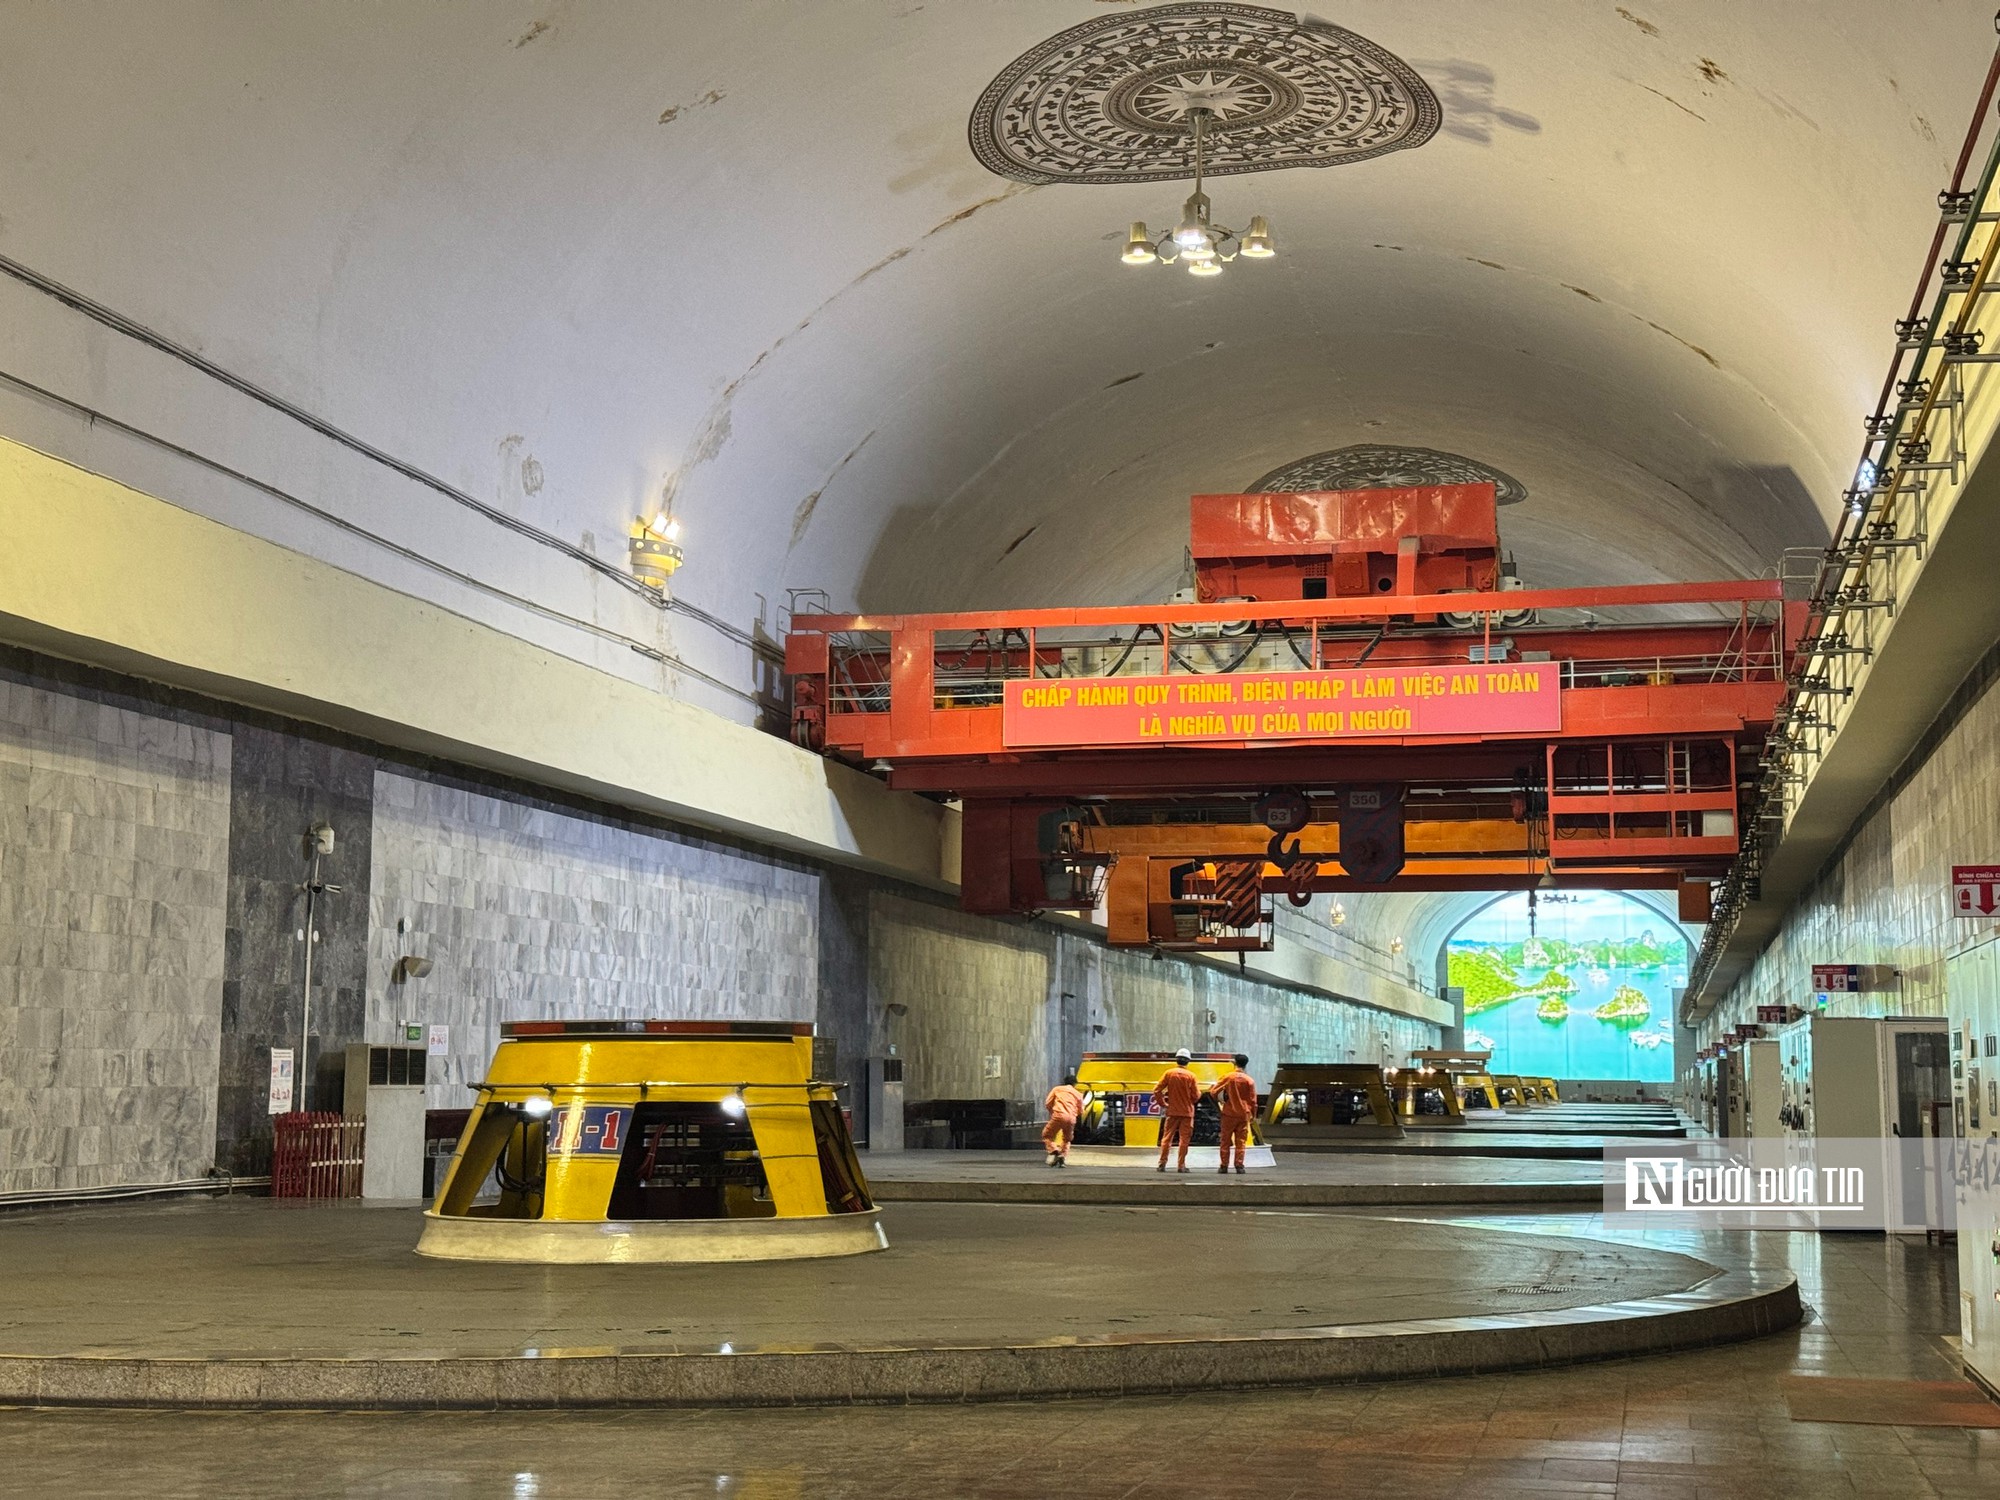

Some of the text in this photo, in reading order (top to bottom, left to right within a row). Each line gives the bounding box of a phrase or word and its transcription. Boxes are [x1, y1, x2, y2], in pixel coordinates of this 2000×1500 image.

[1022, 669, 1540, 708] CHẤP HÀNH QUY TRÌNH, BIỆN PHÁP LÀM VIỆC AN TOÀN
[1139, 704, 1412, 737] LÀ NGHĨA VỤ CỦA MỌI NGƯỜI
[1270, 811, 1287, 821] 63
